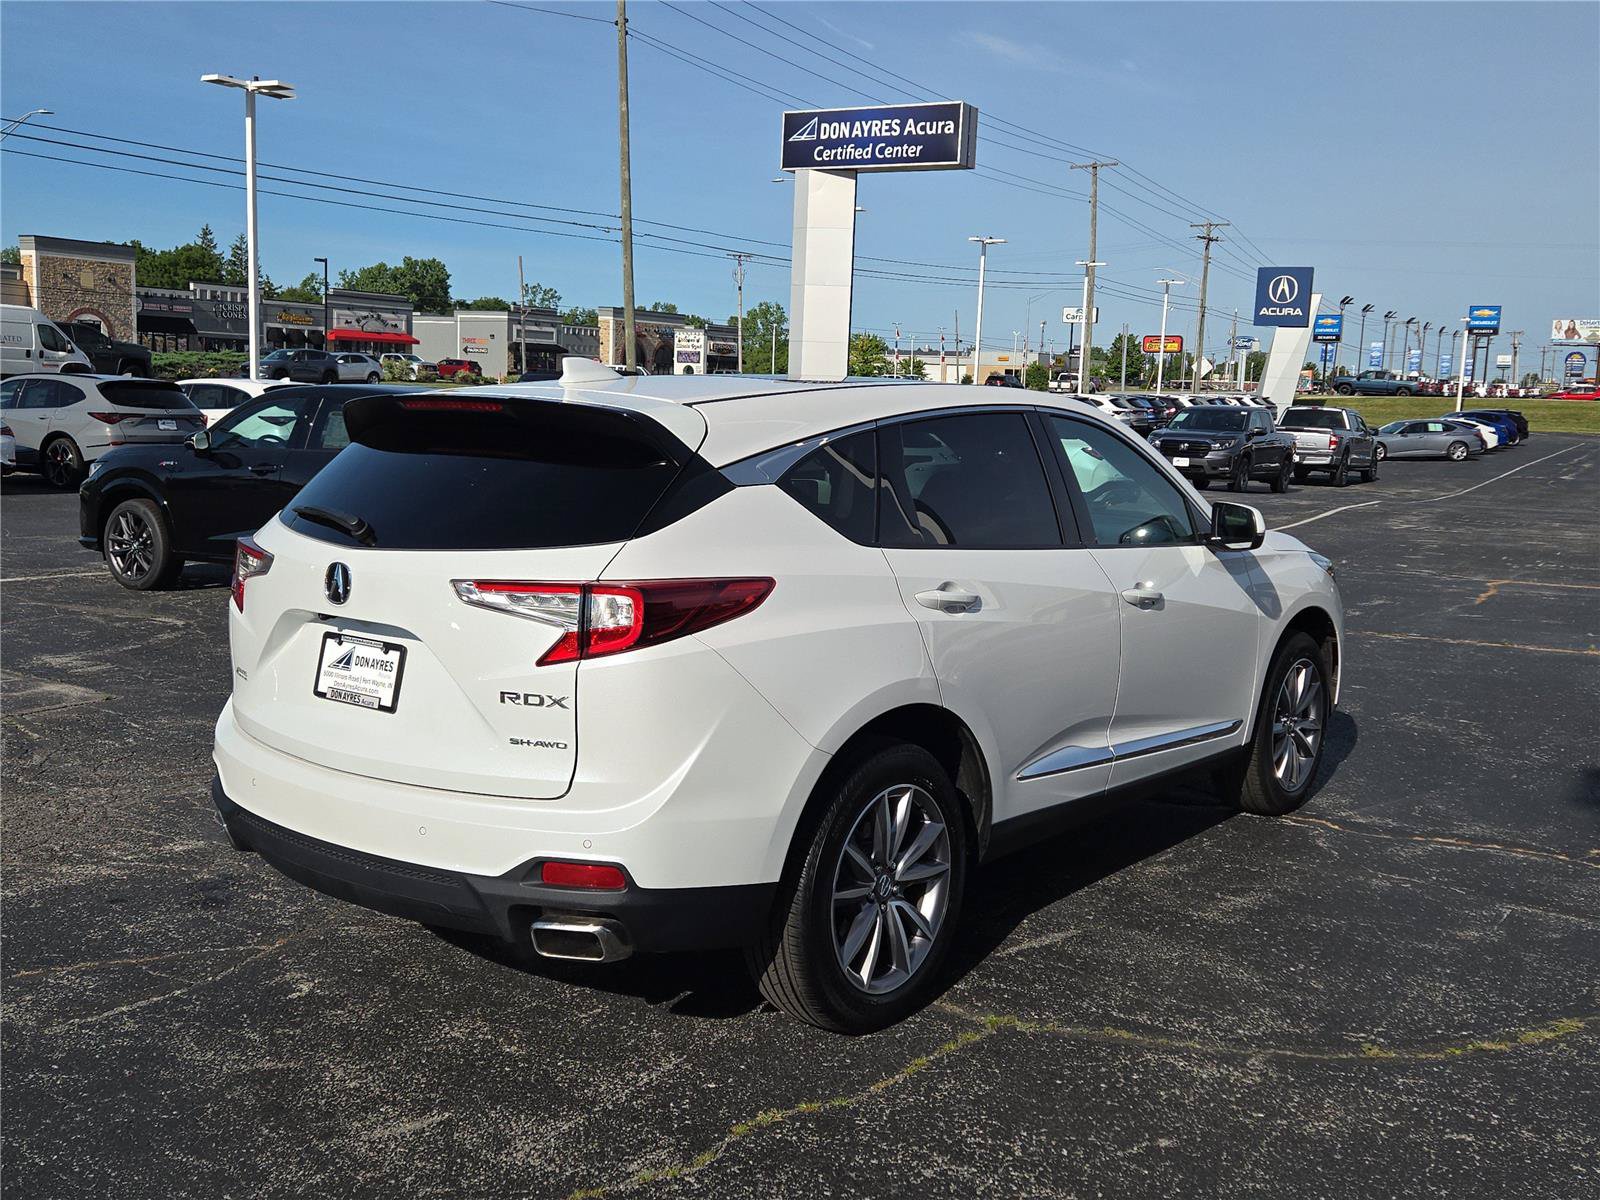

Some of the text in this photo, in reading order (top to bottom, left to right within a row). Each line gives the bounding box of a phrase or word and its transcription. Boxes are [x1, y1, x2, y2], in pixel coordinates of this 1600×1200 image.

[820, 118, 955, 140] DON AYRES Acura
[813, 142, 924, 161] Certified Center
[222, 303, 248, 312] CRISPY
[222, 311, 247, 320] CONES
[1259, 307, 1303, 316] ACURA
[1234, 338, 1253, 347] Ford
[355, 655, 394, 673] DON AYRES
[330, 689, 375, 707] DON AYRES Acura
[500, 691, 570, 710] RDX
